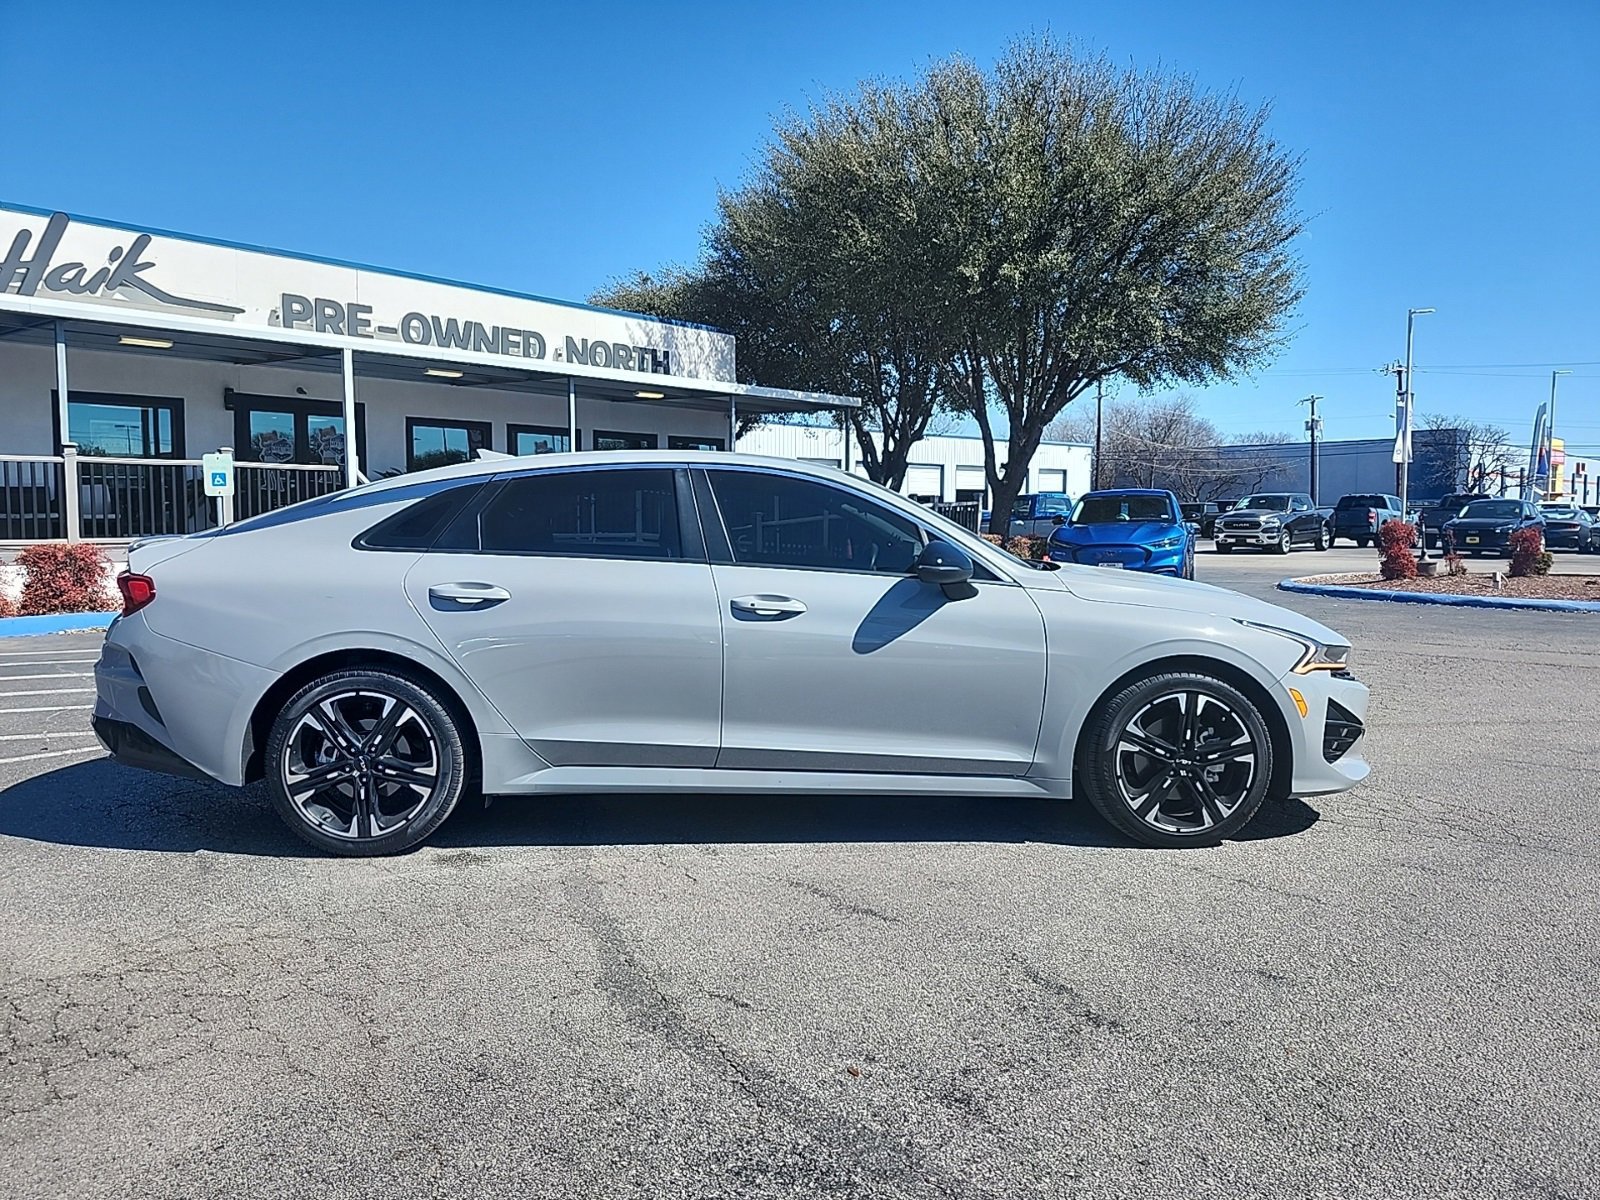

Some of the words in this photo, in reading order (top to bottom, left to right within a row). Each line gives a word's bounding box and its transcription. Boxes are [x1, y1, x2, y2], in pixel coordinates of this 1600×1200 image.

[0, 211, 246, 313] Haik
[281, 292, 547, 360] PRE-OWNED
[565, 335, 671, 375] NORTH
